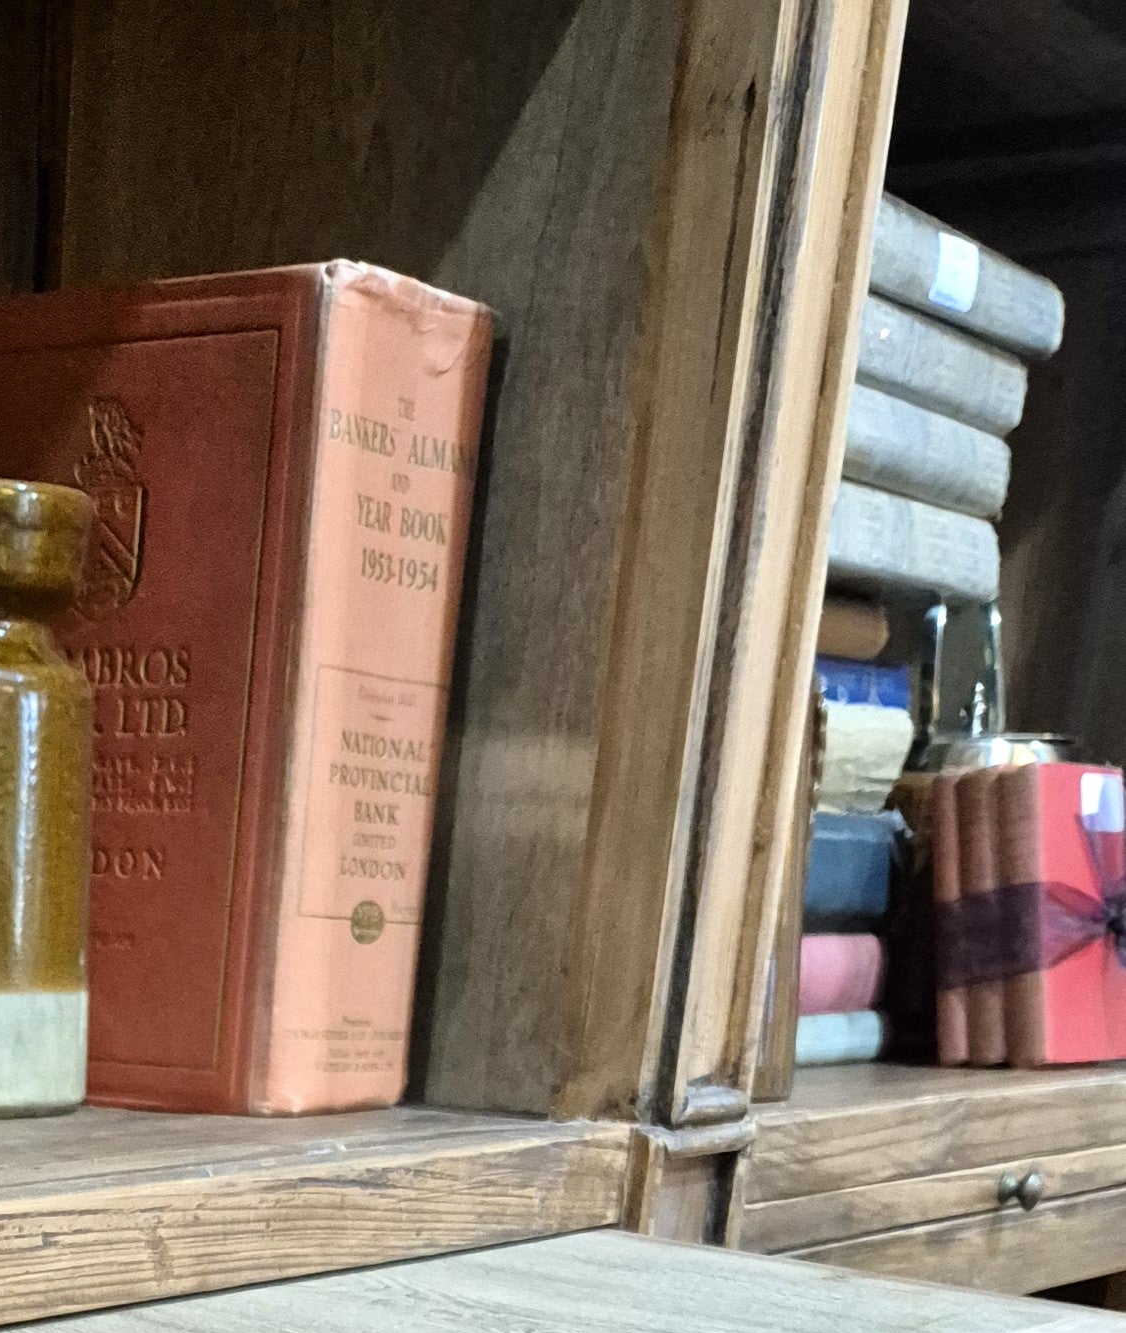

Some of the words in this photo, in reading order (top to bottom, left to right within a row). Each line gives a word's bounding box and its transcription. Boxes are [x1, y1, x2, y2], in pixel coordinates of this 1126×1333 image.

[358, 493, 392, 533] YEAR
[400, 507, 448, 546] BOOK
[354, 800, 400, 826] BANK
[340, 856, 406, 881] LONDON
